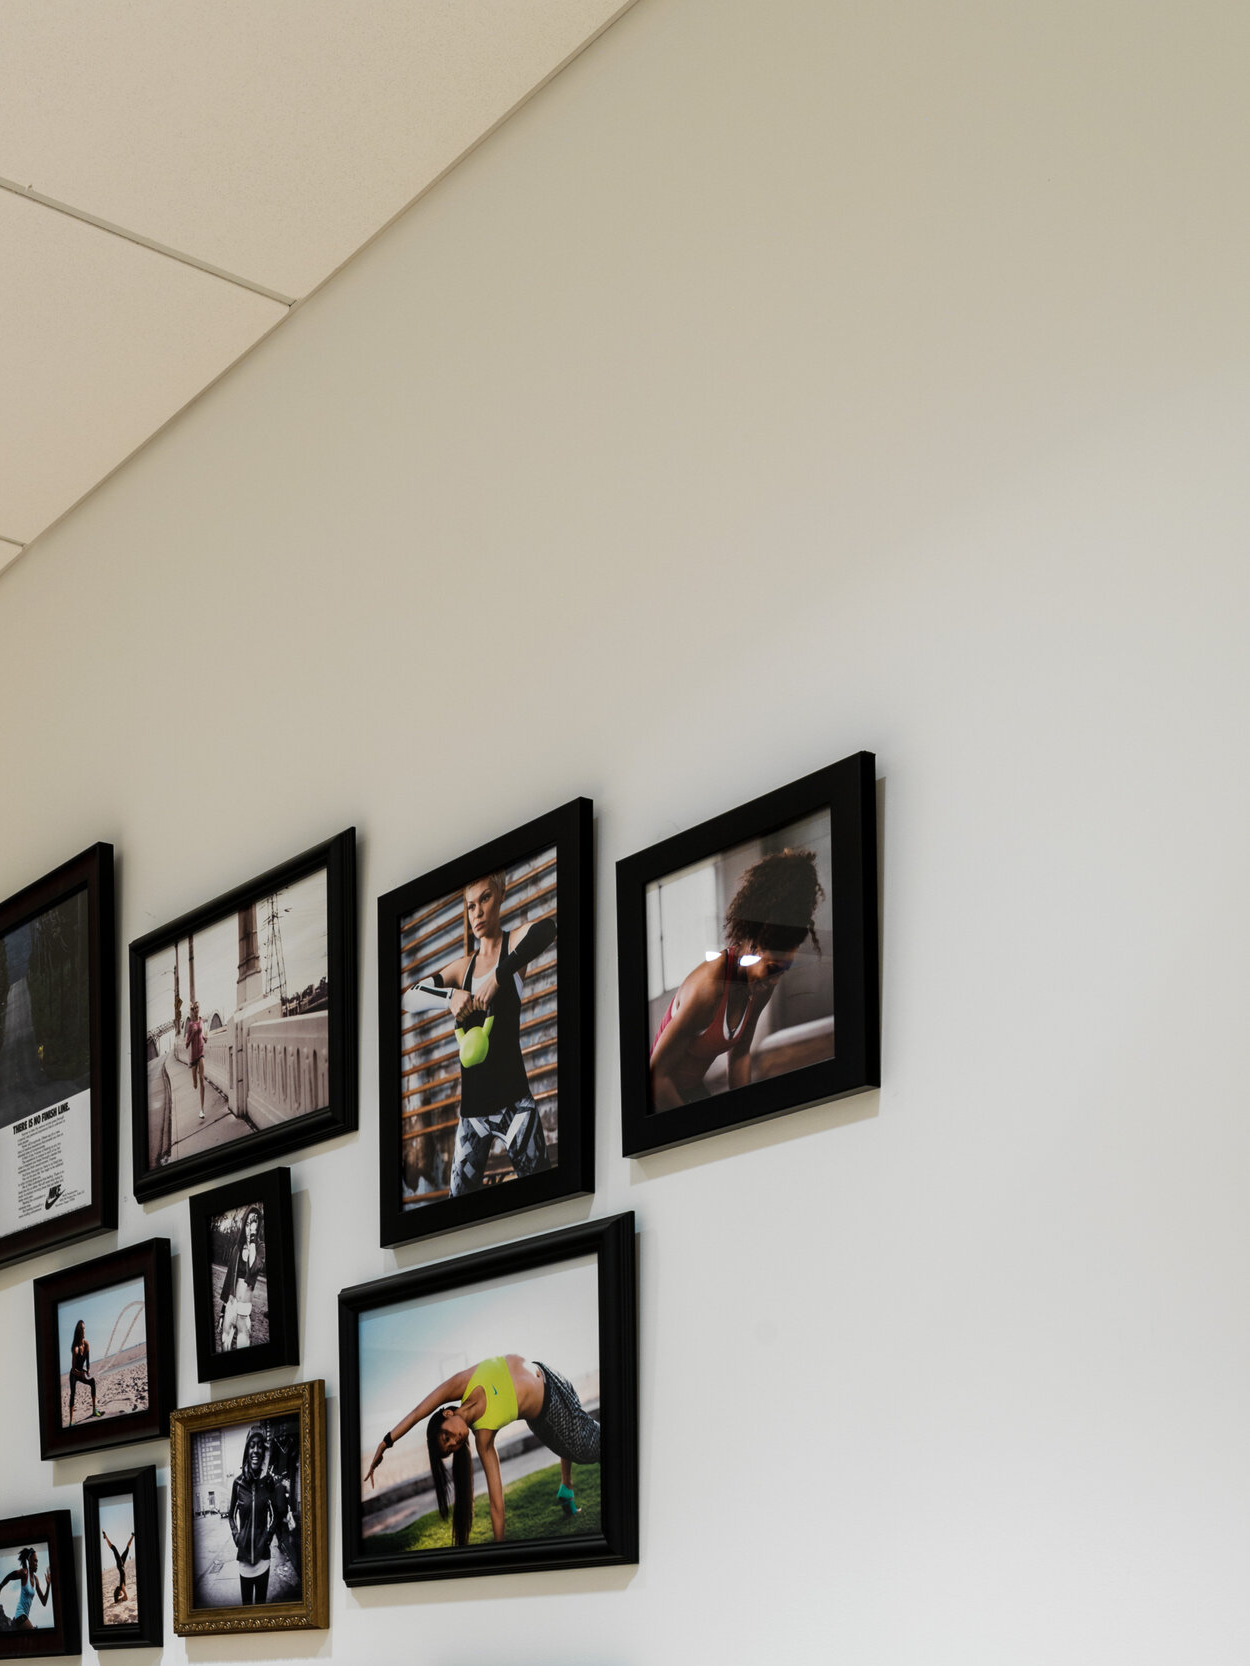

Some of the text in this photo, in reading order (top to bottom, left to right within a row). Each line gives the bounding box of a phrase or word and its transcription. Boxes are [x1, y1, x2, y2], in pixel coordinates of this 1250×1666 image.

[13, 1102, 70, 1135] THERE IS NO FINISH LINE.
